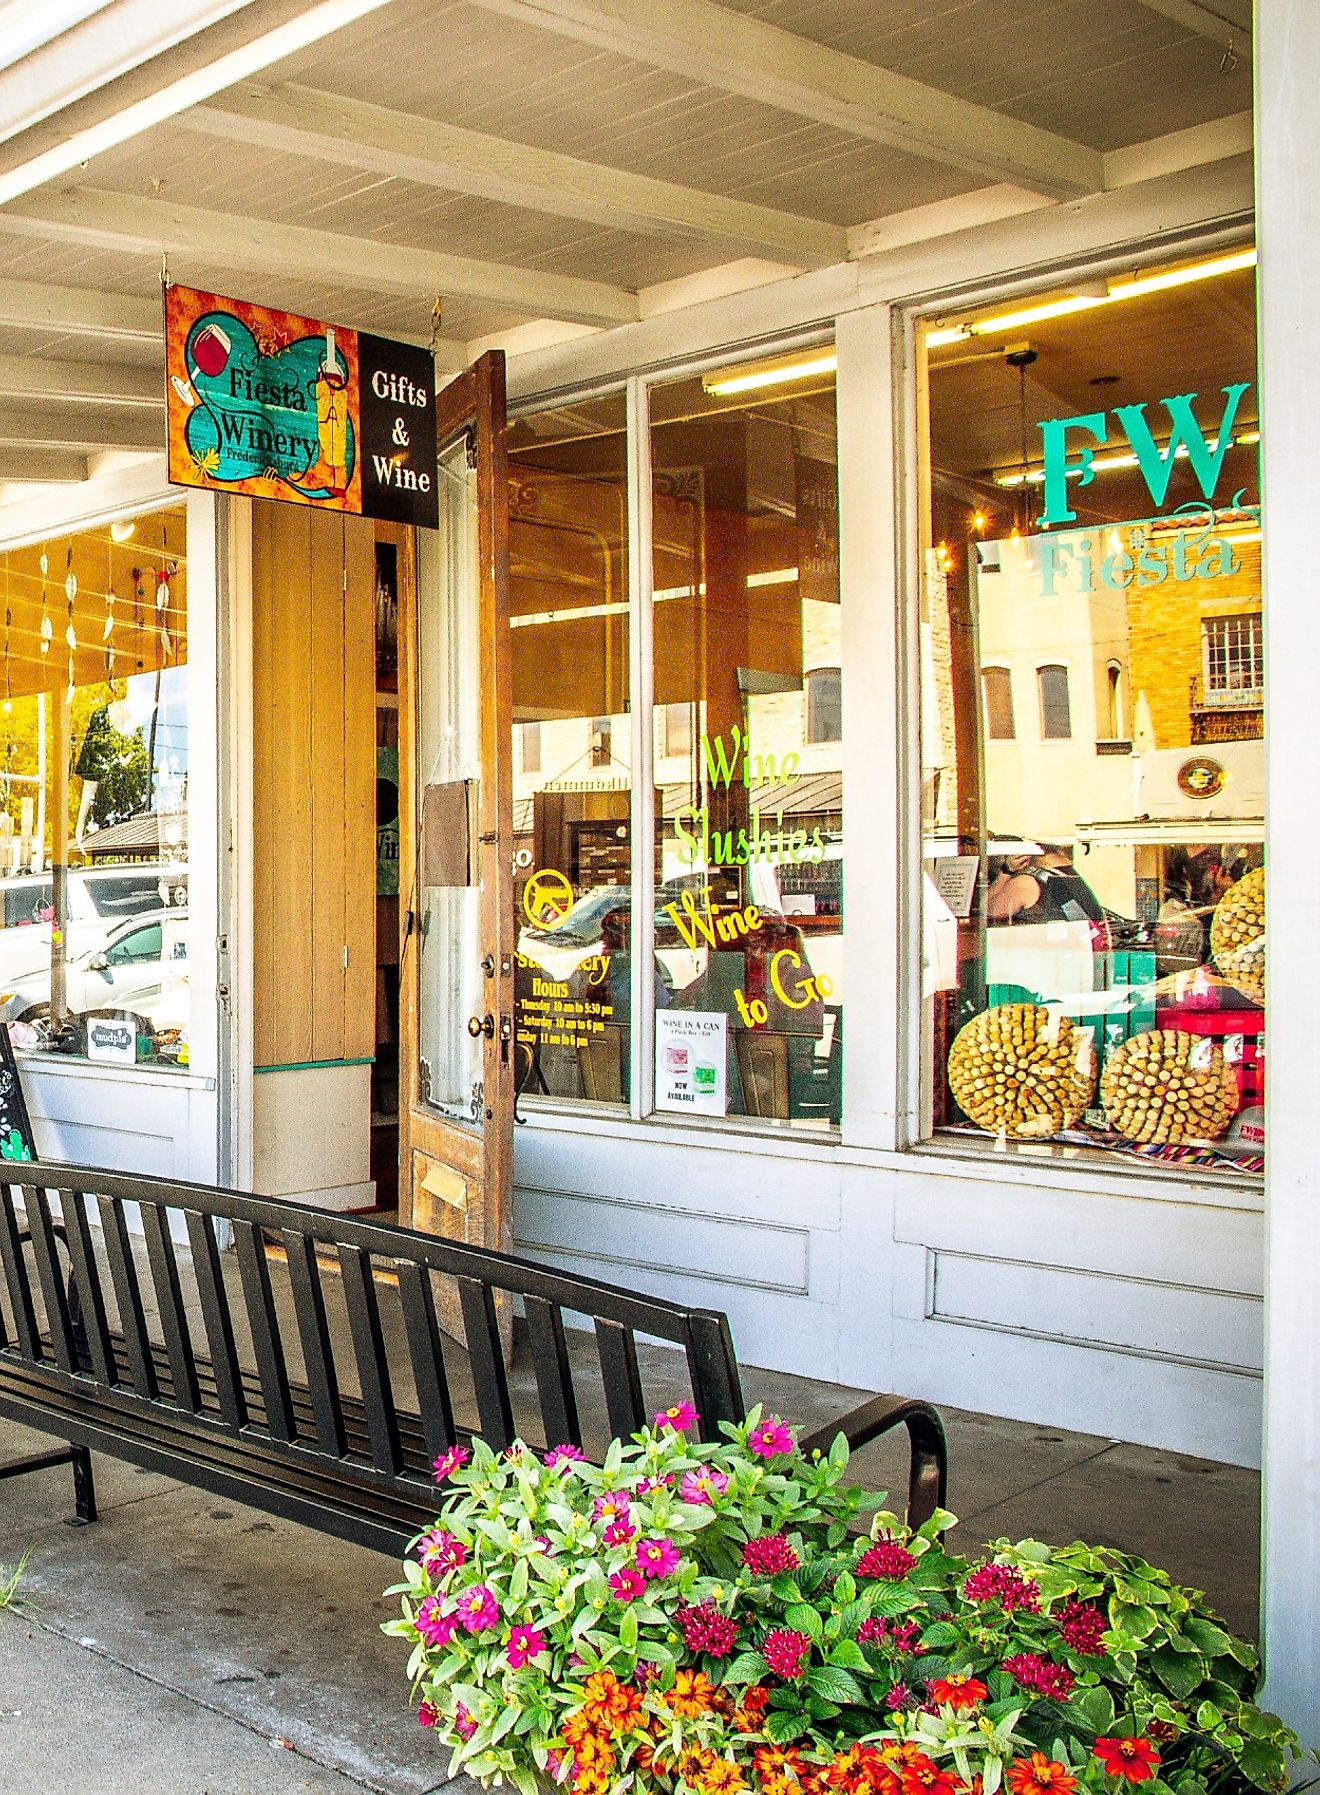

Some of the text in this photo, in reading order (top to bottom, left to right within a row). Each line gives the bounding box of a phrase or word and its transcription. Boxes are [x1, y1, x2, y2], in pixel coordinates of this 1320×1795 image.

[230, 363, 307, 412] Fiesta
[372, 371, 428, 408] Gifts
[219, 413, 319, 472] Winery
[391, 416, 410, 447] &
[1036, 382, 1252, 526] FW
[372, 455, 431, 493] Wine
[1039, 512, 1242, 597] Fiesta
[701, 724, 801, 790] Wine
[673, 804, 828, 866] Slushies
[661, 885, 764, 952] Wine
[532, 977, 569, 998] Hours
[733, 948, 834, 1029] to Go
[521, 999, 551, 1013] Thursday
[575, 1002, 584, 1013] to
[584, 1002, 601, 1015] 5:30
[523, 1015, 553, 1030] Saturday
[577, 1019, 586, 1029] to
[663, 1019, 720, 1031] WINE IN A CAN
[561, 1034, 569, 1045] to
[667, 1091, 695, 1102] AVAILABLE
[675, 1082, 688, 1090] NOW
